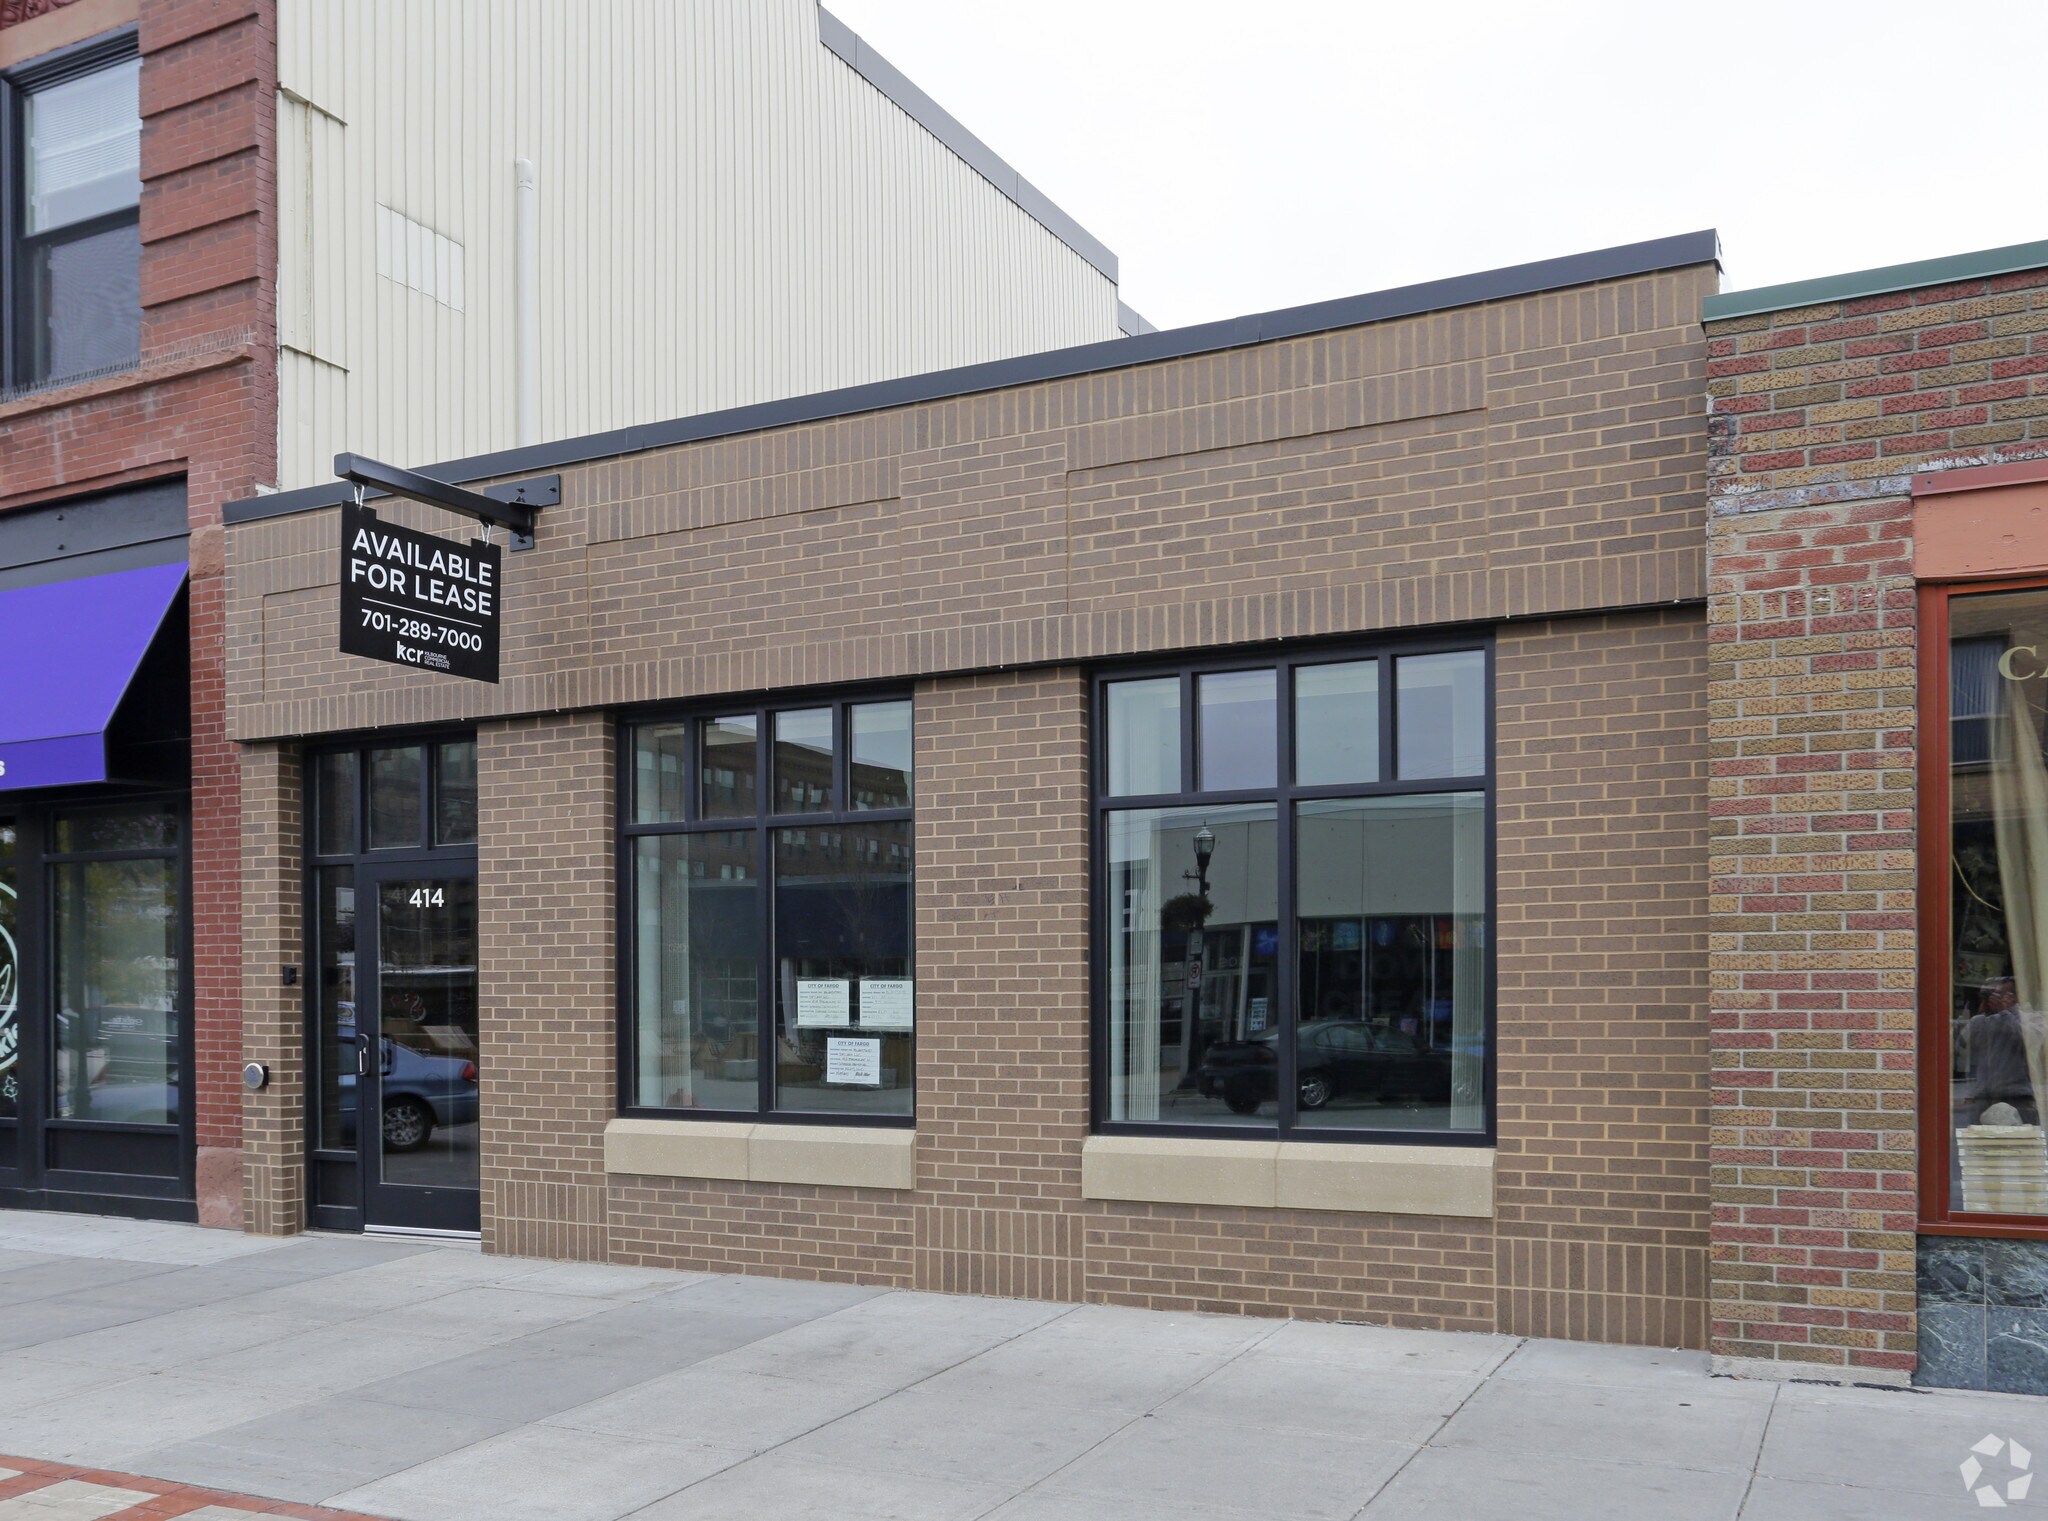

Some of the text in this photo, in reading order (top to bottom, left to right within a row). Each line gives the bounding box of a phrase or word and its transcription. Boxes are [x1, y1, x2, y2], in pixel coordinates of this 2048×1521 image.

[352, 528, 492, 587] AVAILABLE
[351, 558, 492, 616] FOR LEASE
[361, 609, 482, 652] 701-289-7000
[397, 641, 423, 663] kcr
[409, 888, 444, 908] 414
